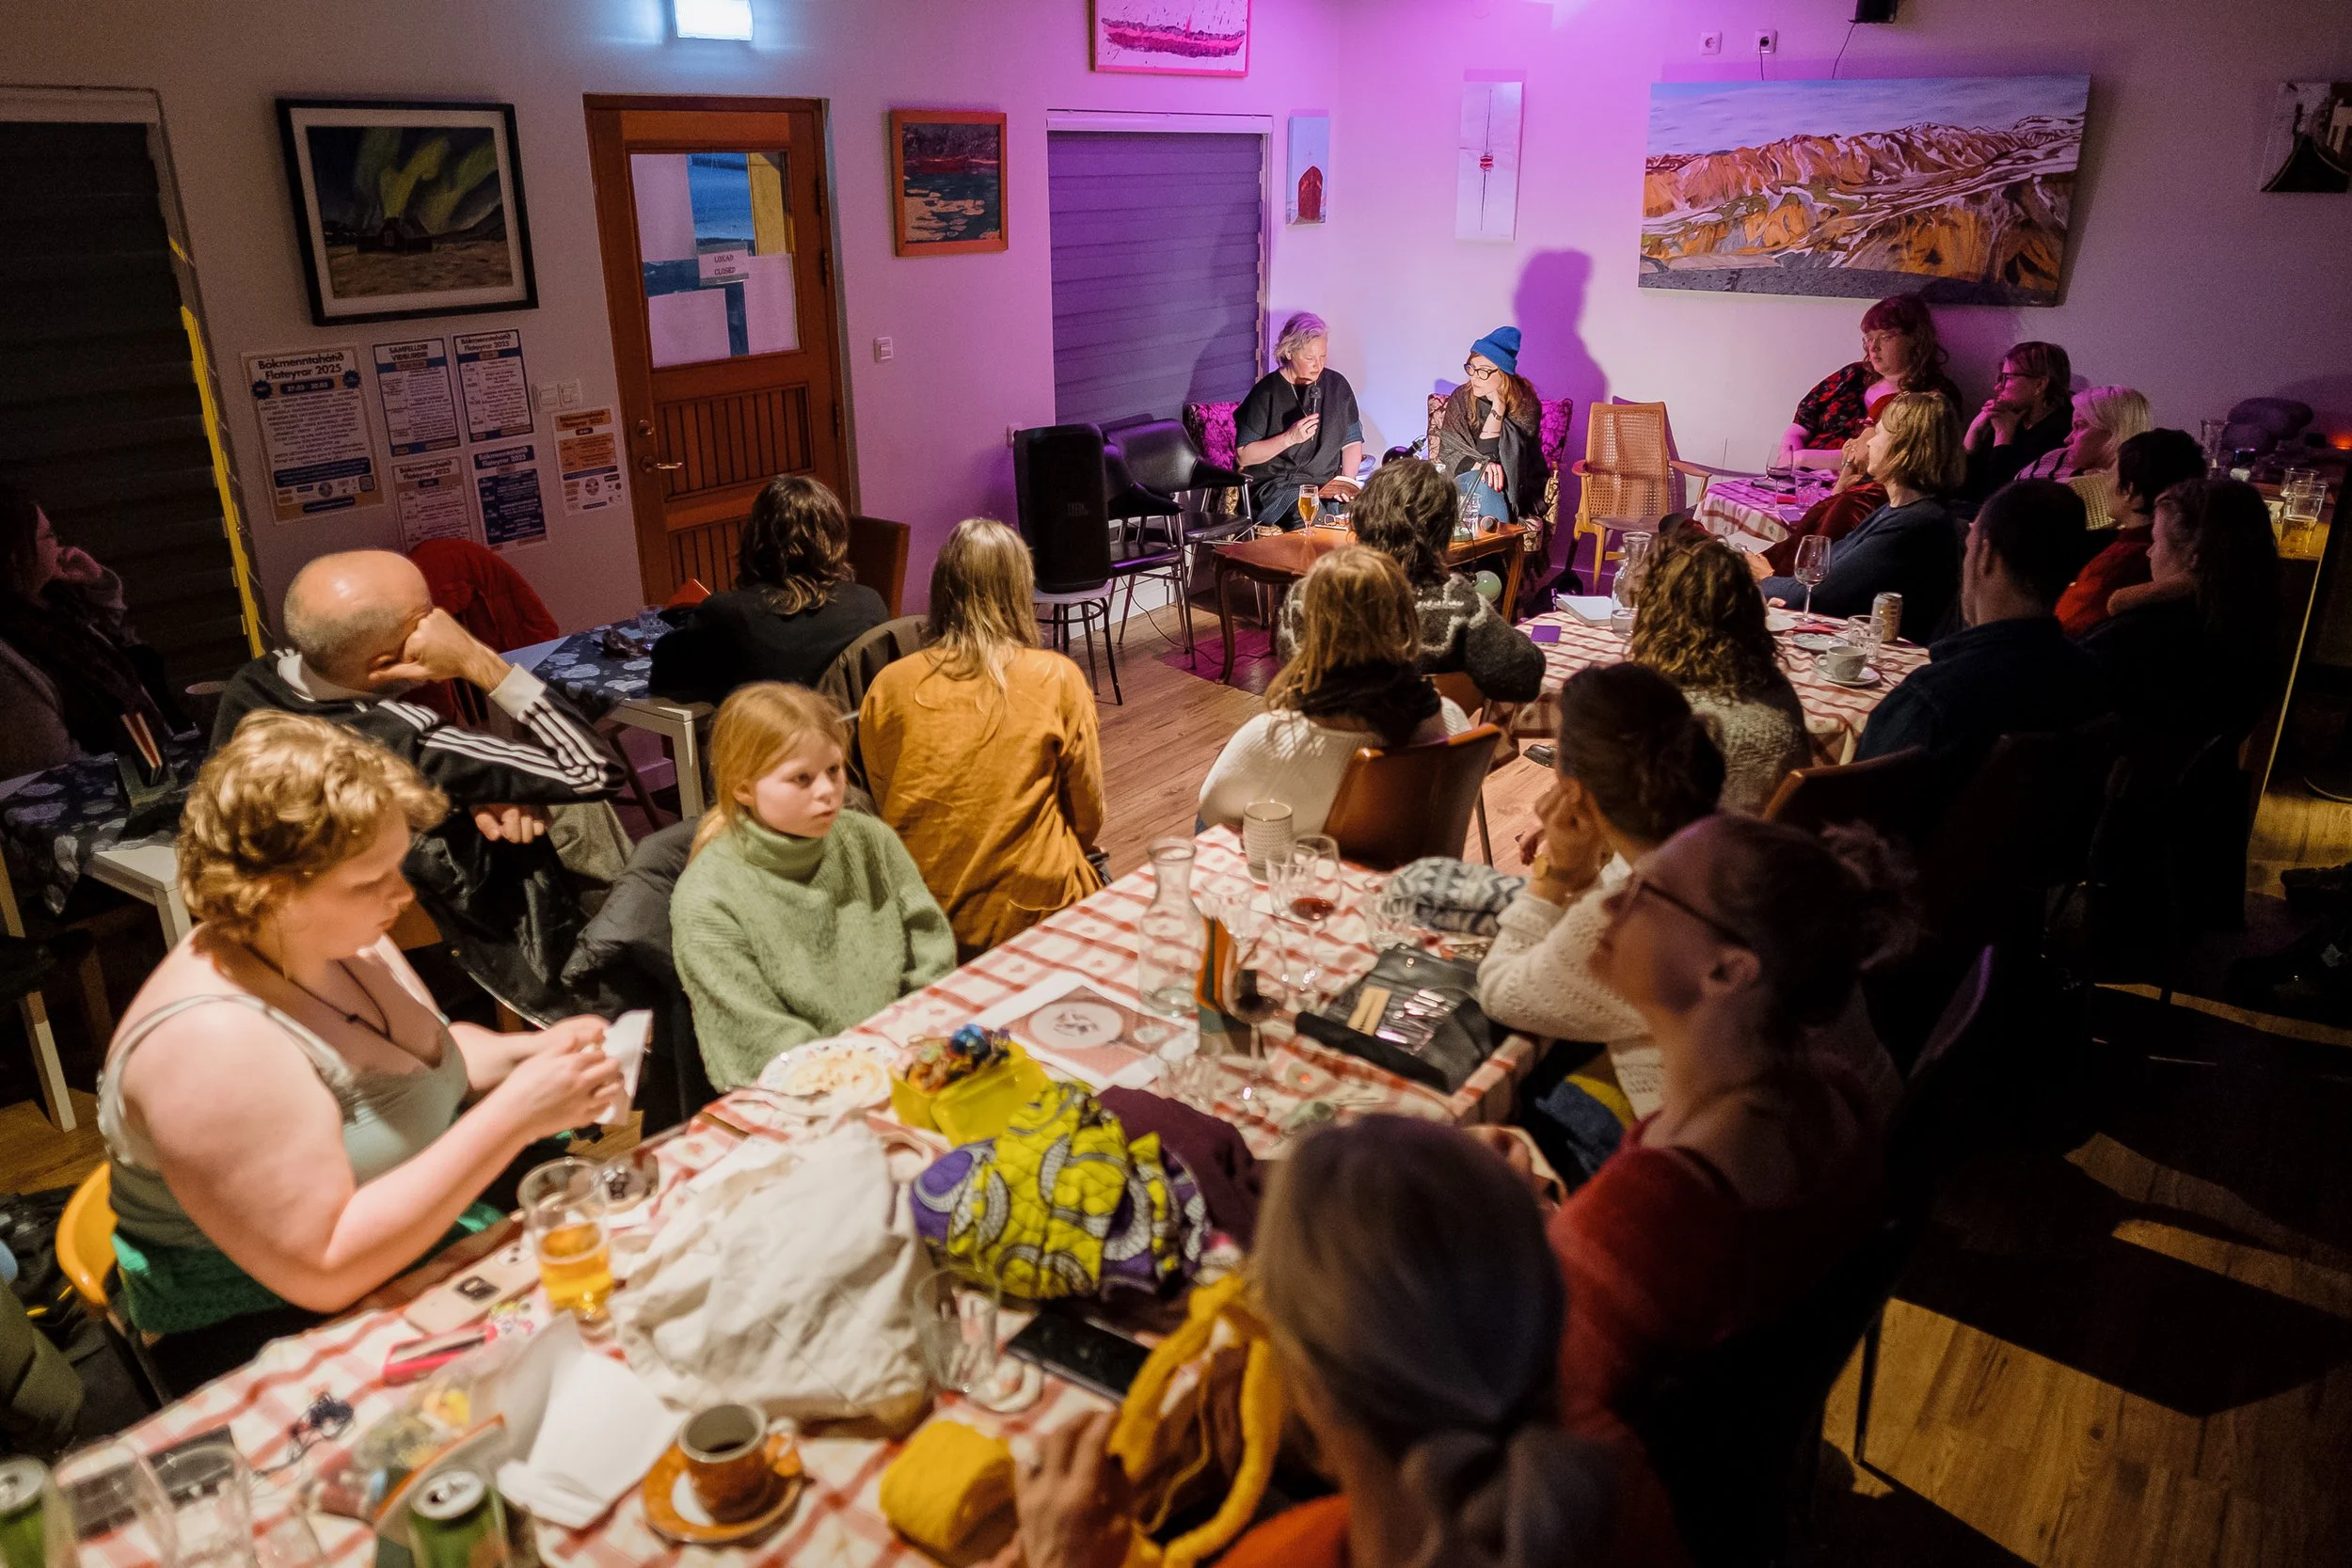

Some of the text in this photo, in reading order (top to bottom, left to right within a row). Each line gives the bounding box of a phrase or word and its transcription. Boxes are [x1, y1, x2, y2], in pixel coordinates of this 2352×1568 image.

[714, 266, 736, 275] CLOSED
[258, 352, 344, 370] Bókmenntahátíð
[264, 364, 342, 380] Flateyrar 2025
